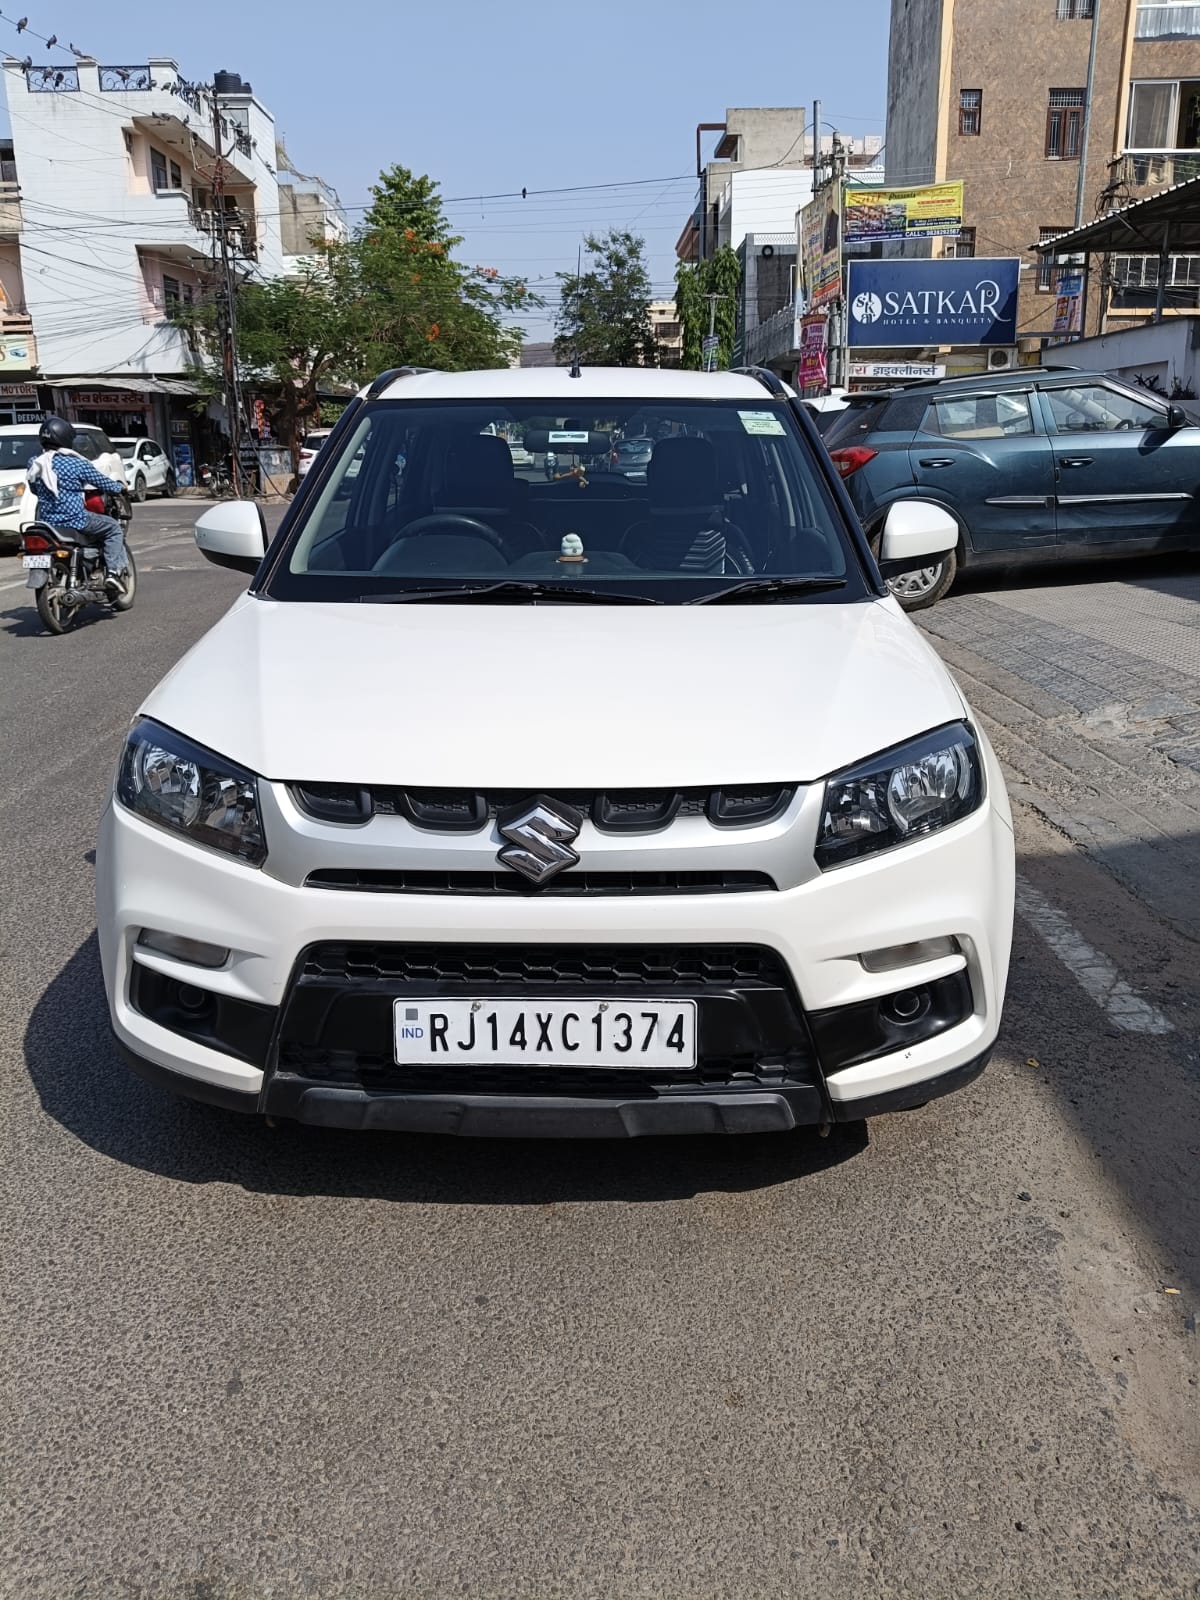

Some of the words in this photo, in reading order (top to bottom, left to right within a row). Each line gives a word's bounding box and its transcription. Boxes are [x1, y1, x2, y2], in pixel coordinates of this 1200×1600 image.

[883, 279, 1012, 322] SATKAR
[936, 317, 992, 325] BANQUETS
[872, 364, 938, 377] ड्राइक्लीनर्स
[1, 384, 37, 394] MOTORS
[401, 1027, 424, 1039] IND
[429, 1012, 686, 1053] RJ14XC1374
